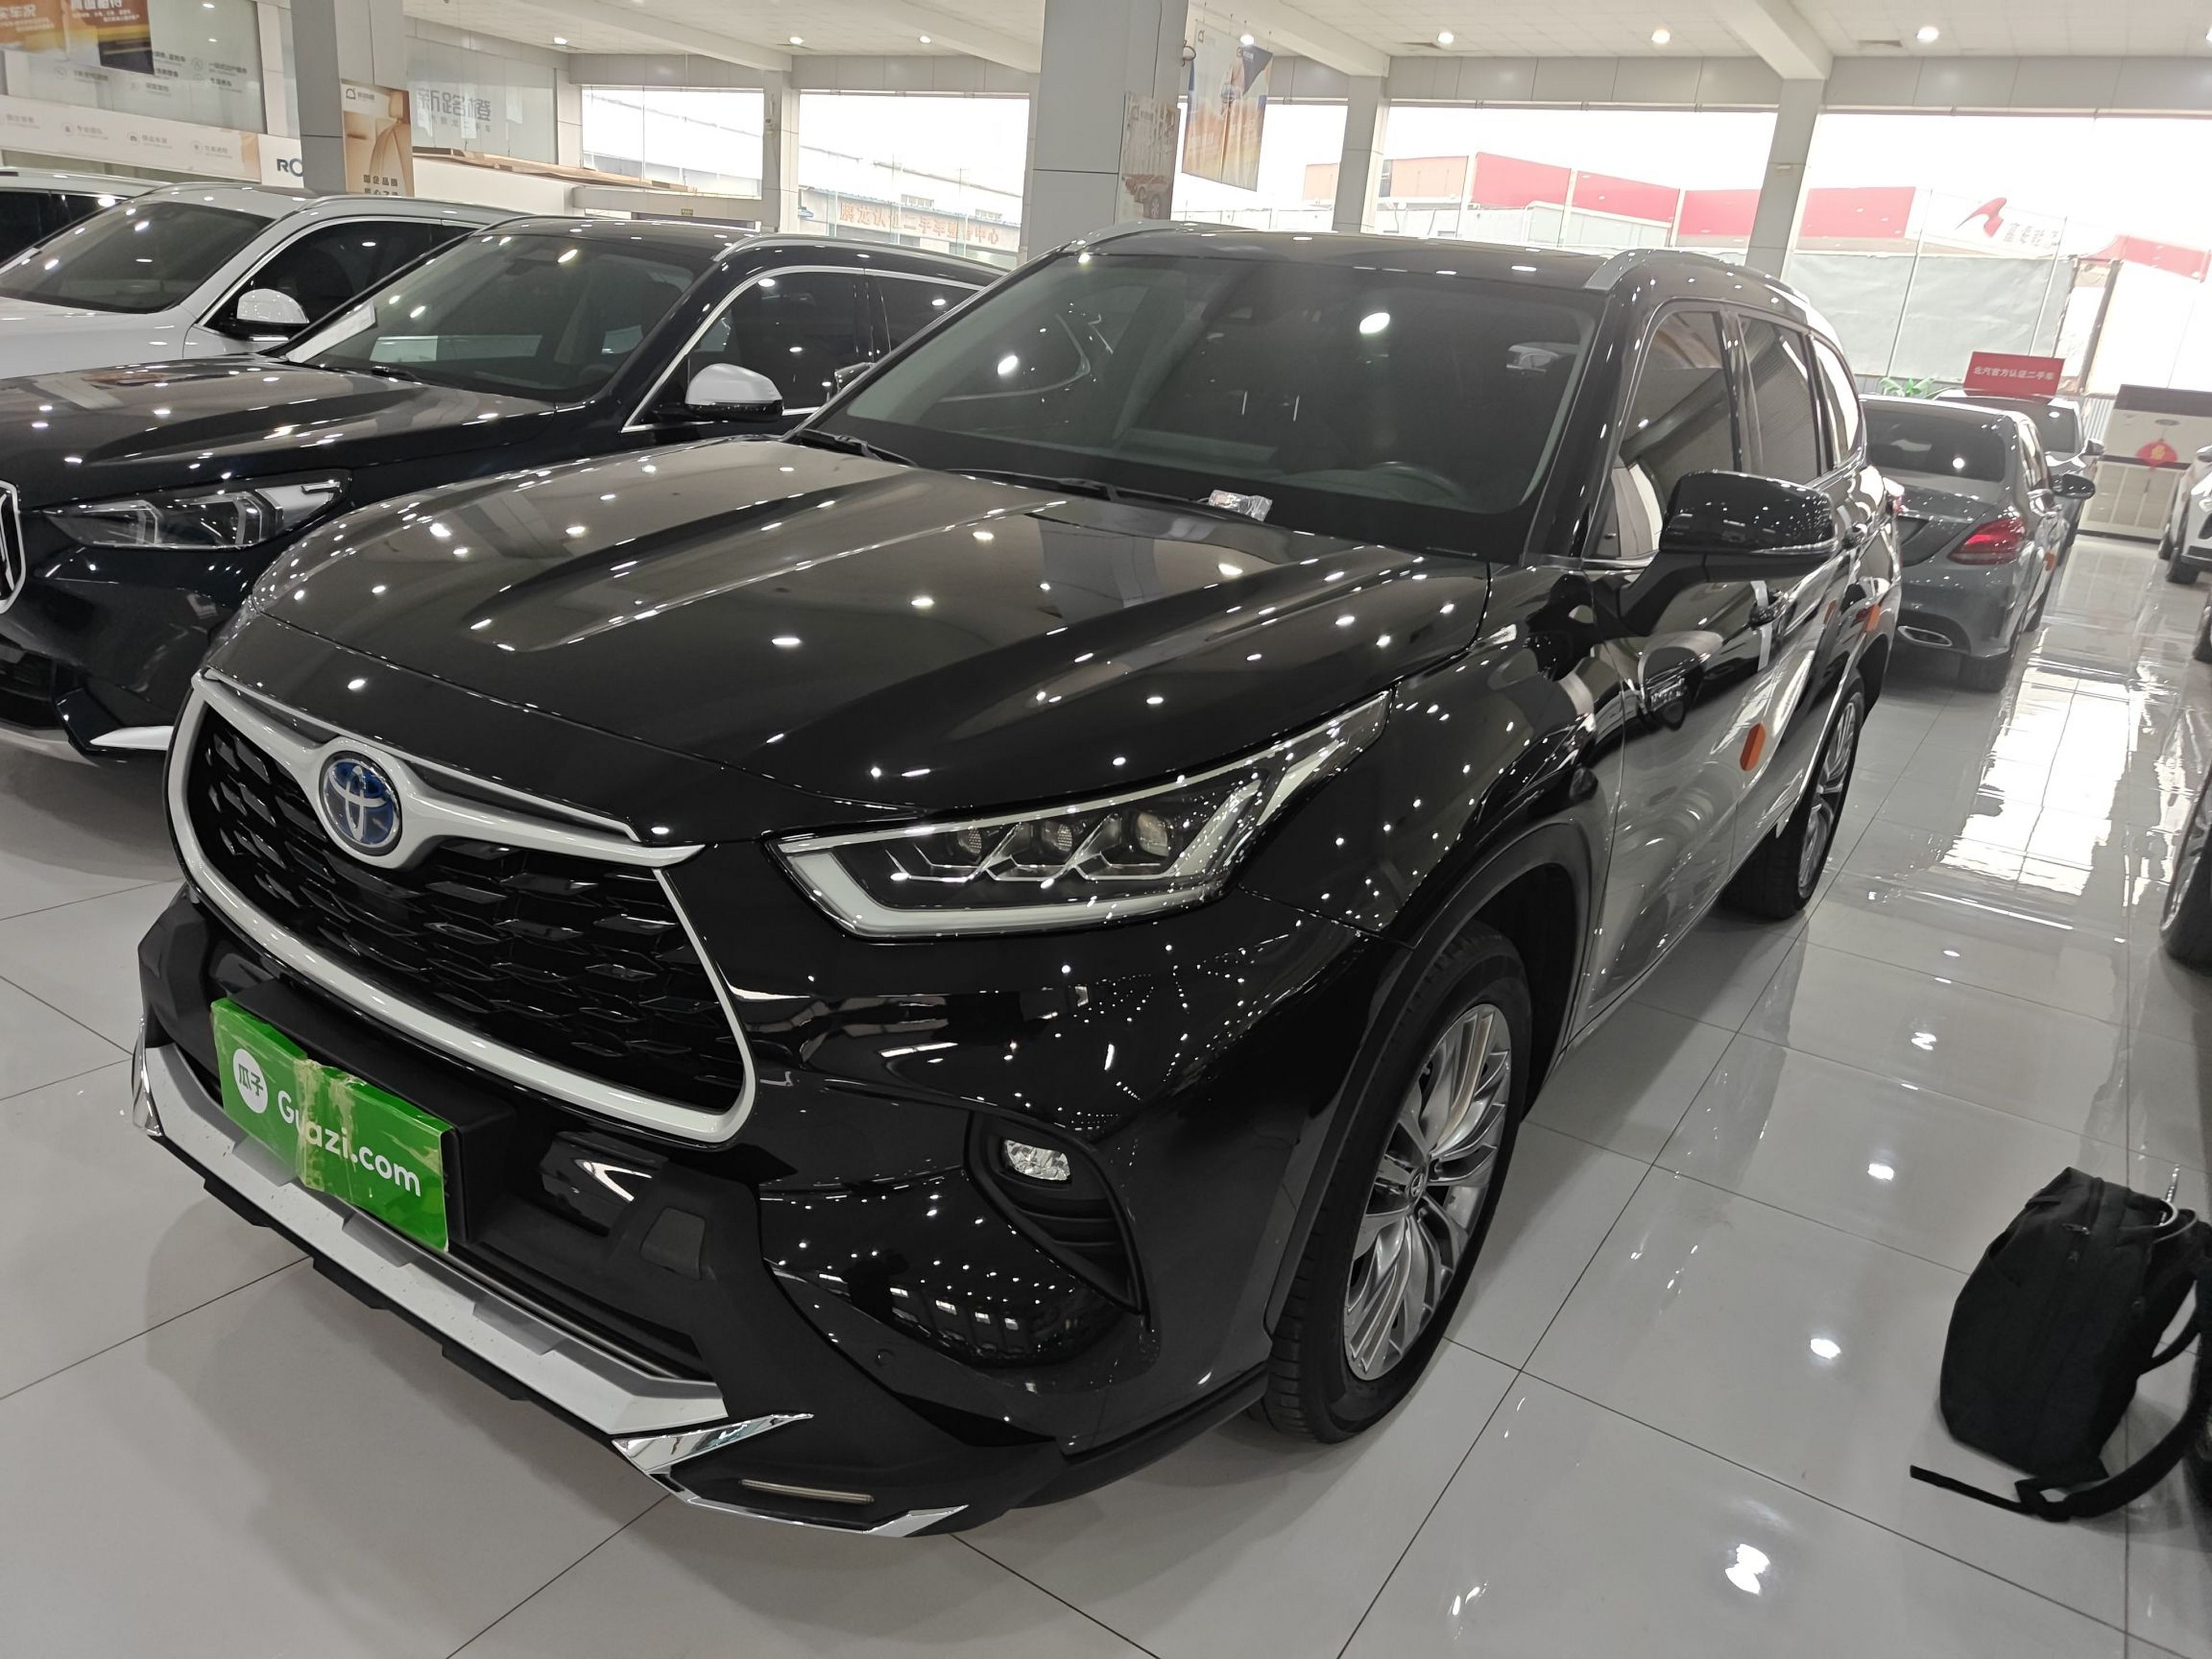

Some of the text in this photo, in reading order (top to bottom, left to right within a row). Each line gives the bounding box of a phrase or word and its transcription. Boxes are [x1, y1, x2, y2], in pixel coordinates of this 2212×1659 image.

[415, 88, 491, 122] 新路橙
[238, 1063, 263, 1096] 瓜子
[278, 1090, 421, 1197] Guazi.com
